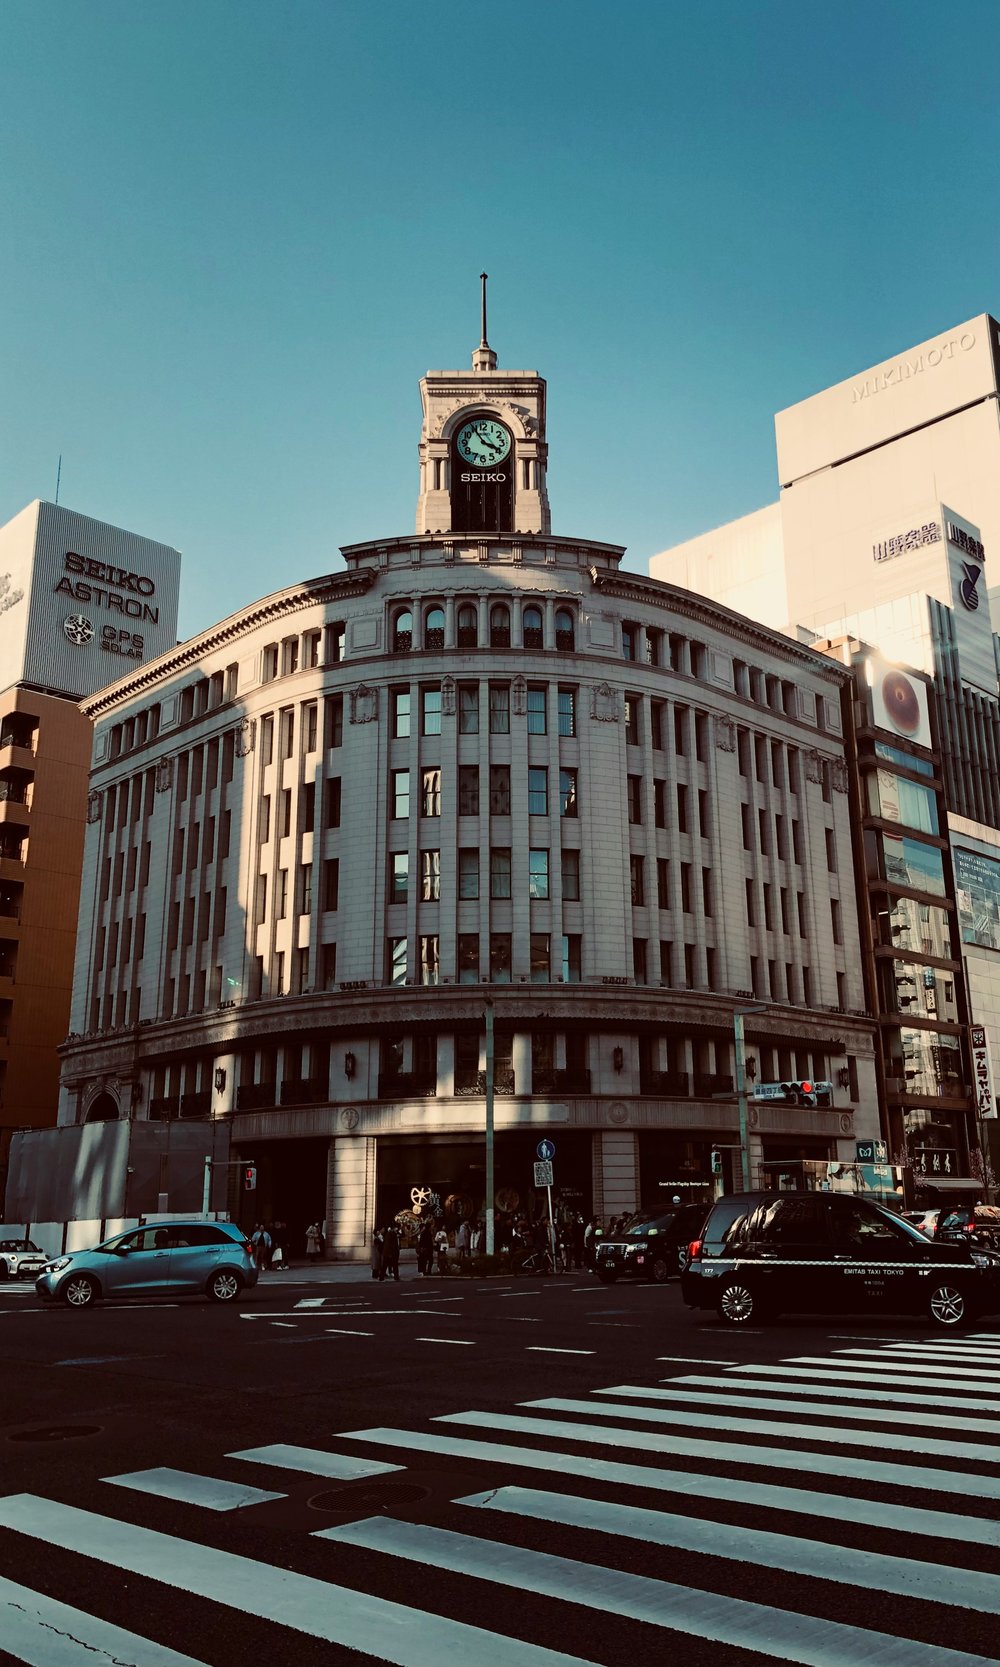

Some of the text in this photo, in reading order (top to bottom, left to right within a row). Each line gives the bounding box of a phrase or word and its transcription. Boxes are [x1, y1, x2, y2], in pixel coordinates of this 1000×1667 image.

[851, 333, 976, 404] MIKIMOTO
[479, 423, 488, 431] 12
[464, 431, 472, 439] 10
[461, 439, 468, 447] 9
[499, 439, 505, 447] 3
[464, 447, 471, 455] 8
[480, 455, 487, 463] 6
[488, 453, 495, 461] 5
[461, 473, 506, 482] SEIKO
[65, 552, 155, 596] SEIKO
[55, 577, 159, 624] ASTRON
[102, 625, 144, 649] GPS
[101, 640, 143, 660] SOLAR
